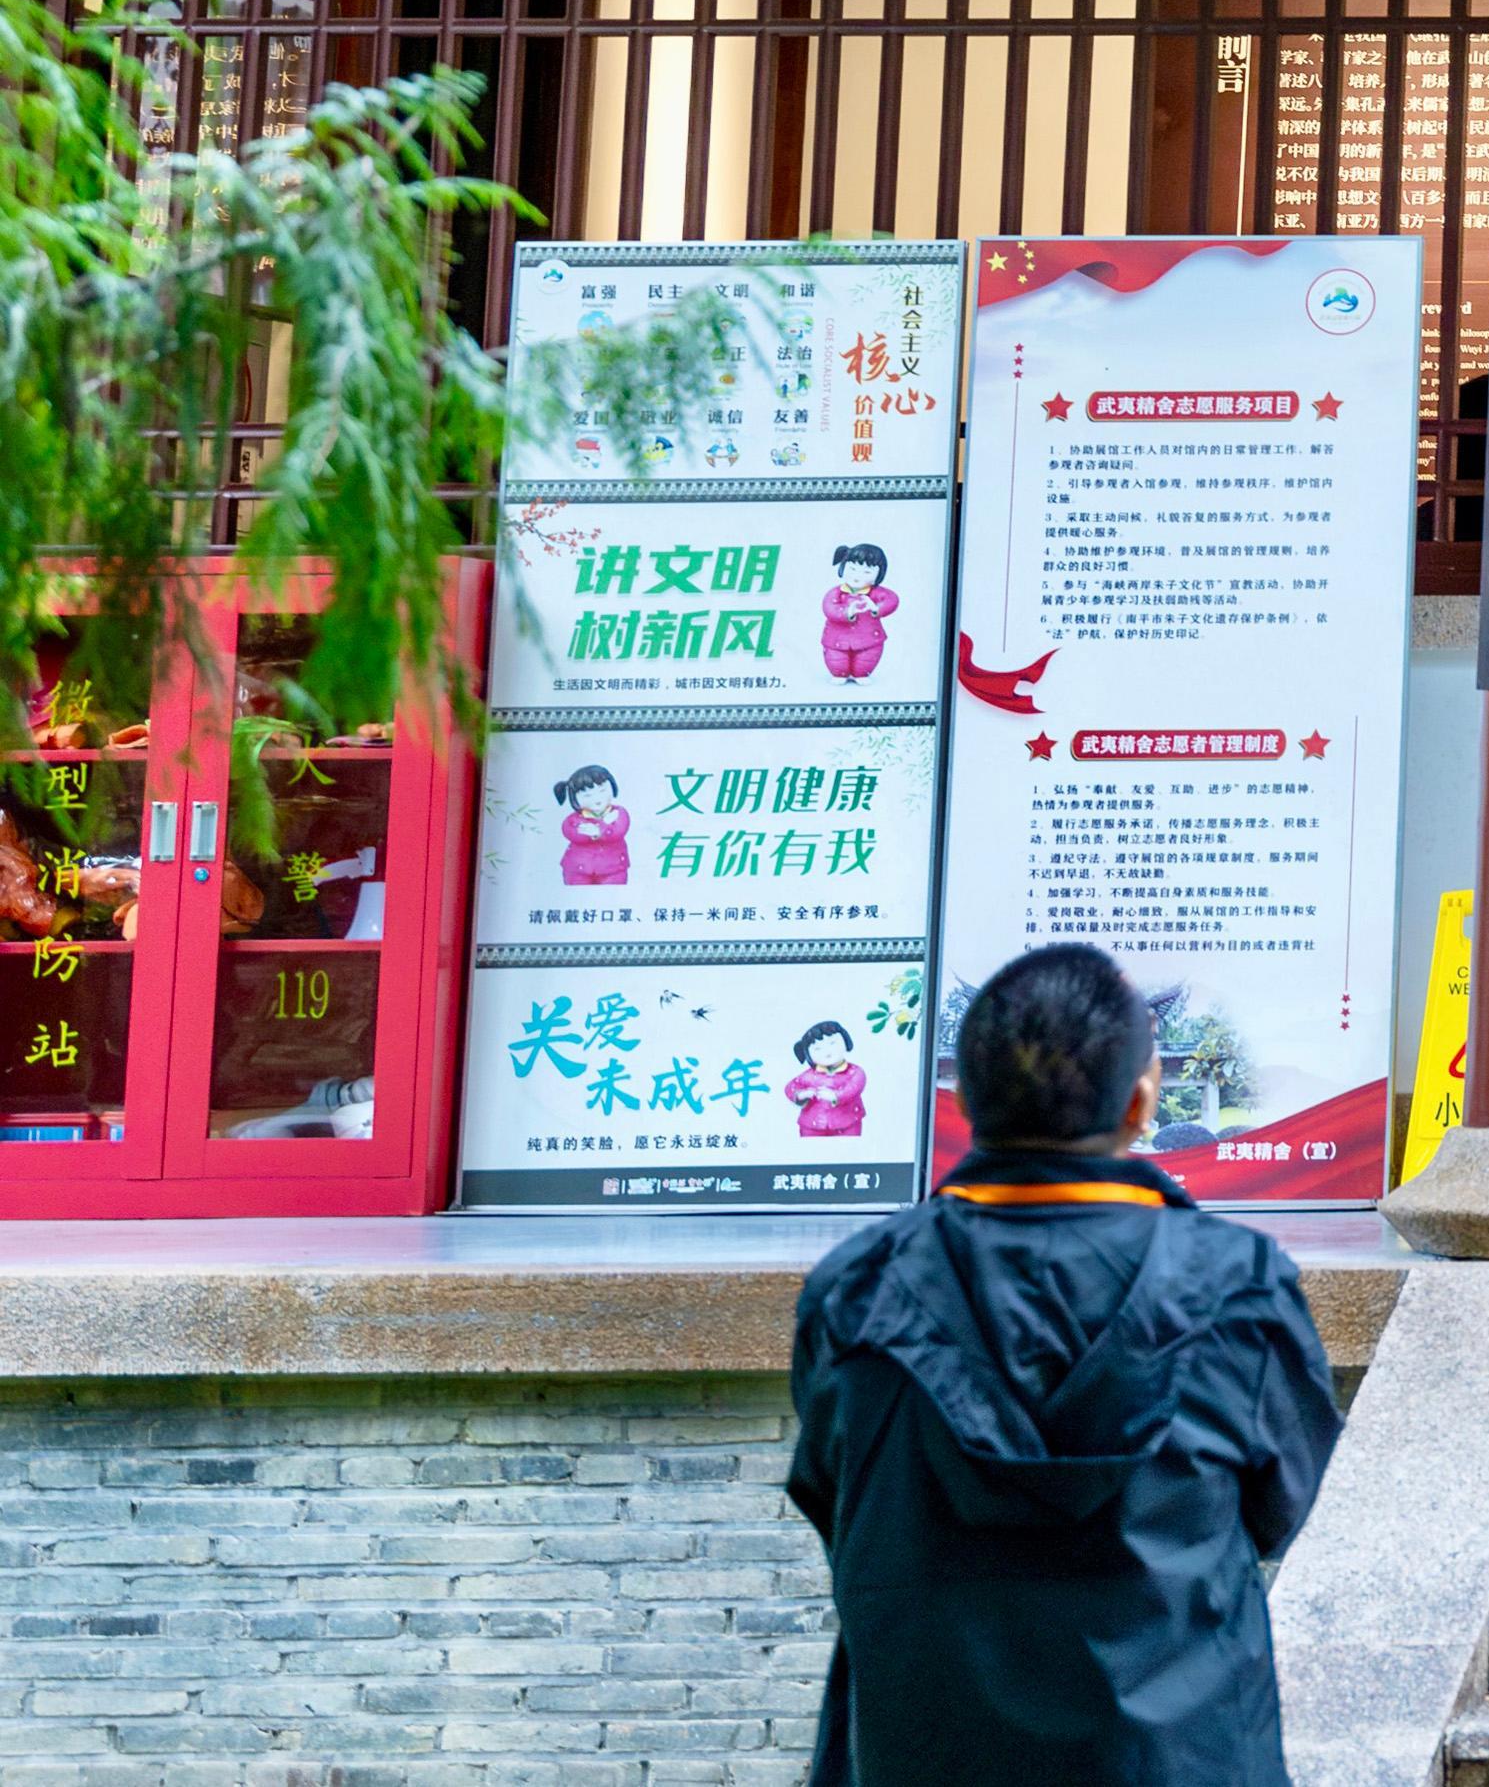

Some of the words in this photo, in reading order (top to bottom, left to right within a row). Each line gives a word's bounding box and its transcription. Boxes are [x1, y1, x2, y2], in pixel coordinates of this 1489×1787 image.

[581, 284, 616, 300] 富强
[648, 284, 683, 300] 民主
[715, 283, 749, 298] 文明
[780, 283, 816, 298] 和谐
[777, 345, 813, 361] 法治
[900, 285, 924, 378] 社会主义
[838, 330, 938, 417] 核心
[708, 409, 744, 425] 诚信
[773, 408, 809, 425] 友善
[850, 394, 875, 463] 价值观
[1096, 396, 1292, 416] 武夷精舍志愿服务项目
[574, 543, 781, 597] 讲文明
[567, 609, 777, 662] 树新风
[1081, 735, 1280, 755] 武夷精舍志愿者管理制度
[656, 764, 883, 816] 文明健康
[656, 827, 878, 879] 有你有我
[274, 969, 331, 1020] 119
[508, 992, 641, 1079] 关爱
[586, 1055, 770, 1118] 未成年
